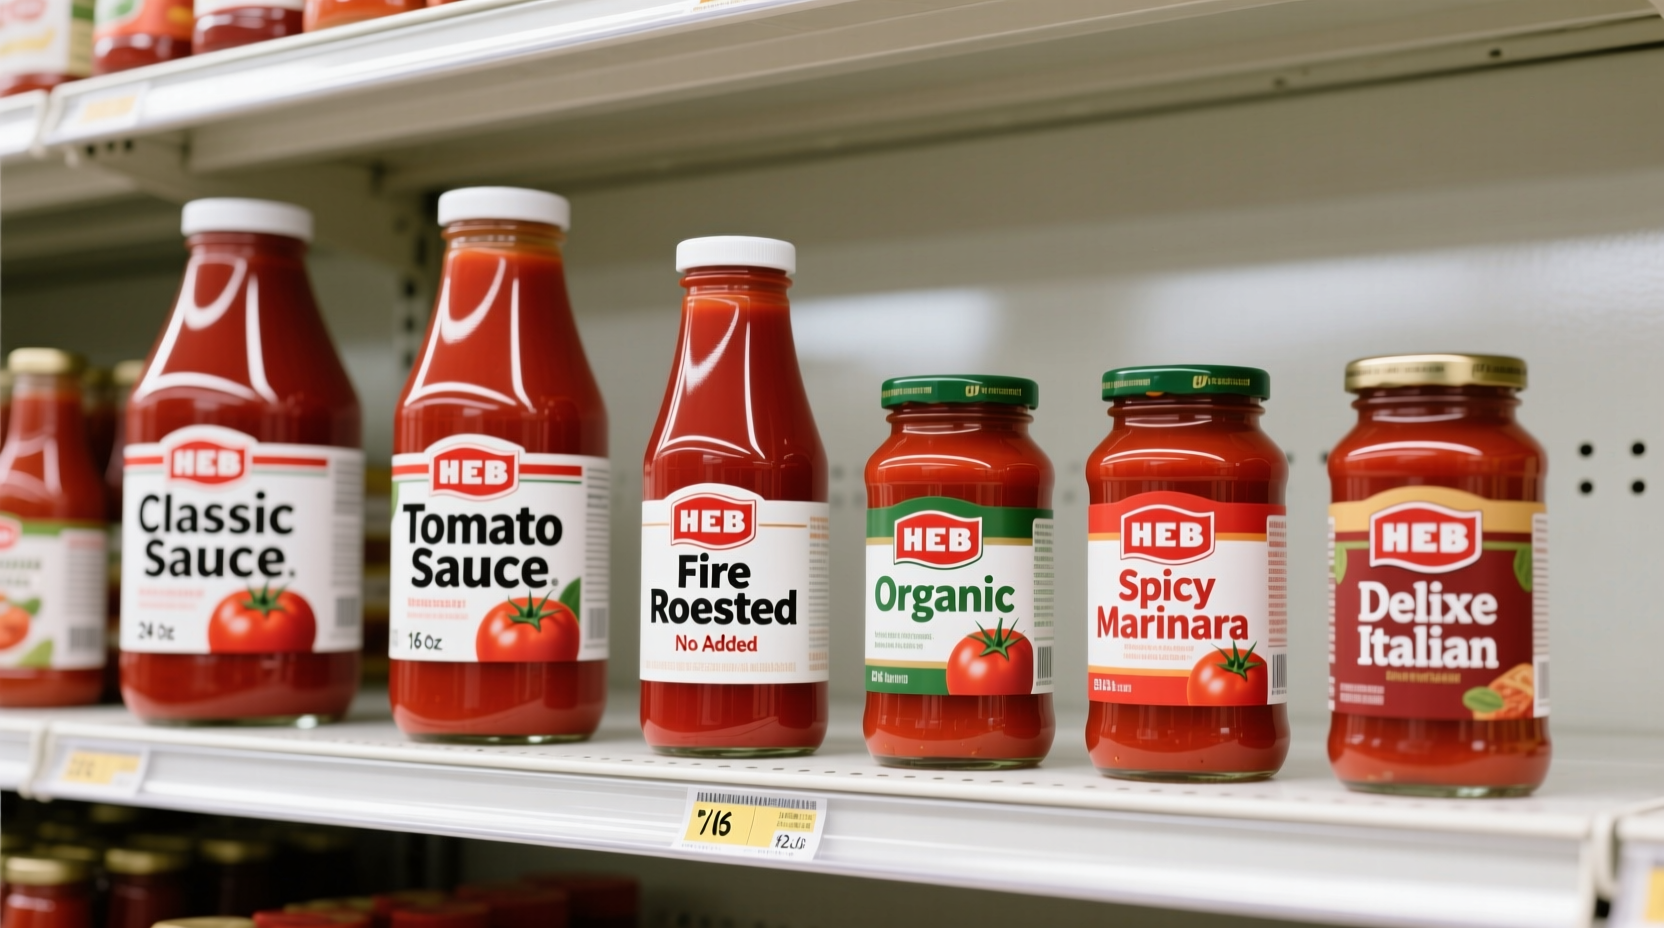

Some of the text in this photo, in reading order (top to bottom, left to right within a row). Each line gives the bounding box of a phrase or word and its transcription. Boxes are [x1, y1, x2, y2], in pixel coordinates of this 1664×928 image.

[172, 450, 242, 477] HEB
[439, 459, 508, 485] HEB
[139, 491, 295, 535] Classic
[403, 504, 563, 546] Tomato
[680, 509, 746, 533] HEB
[904, 527, 972, 552] HEB
[1131, 521, 1204, 548] HEB
[1382, 522, 1469, 553] HEB
[678, 552, 751, 589] Fire
[651, 588, 797, 625] Roested
[875, 575, 1015, 623] Organic
[1119, 568, 1216, 610] Spicy
[1357, 581, 1498, 625] Delixe
[1097, 605, 1248, 640] Marinara
[408, 631, 421, 650] 16
[675, 634, 758, 652] No Added
[1357, 625, 1500, 669] Italian
